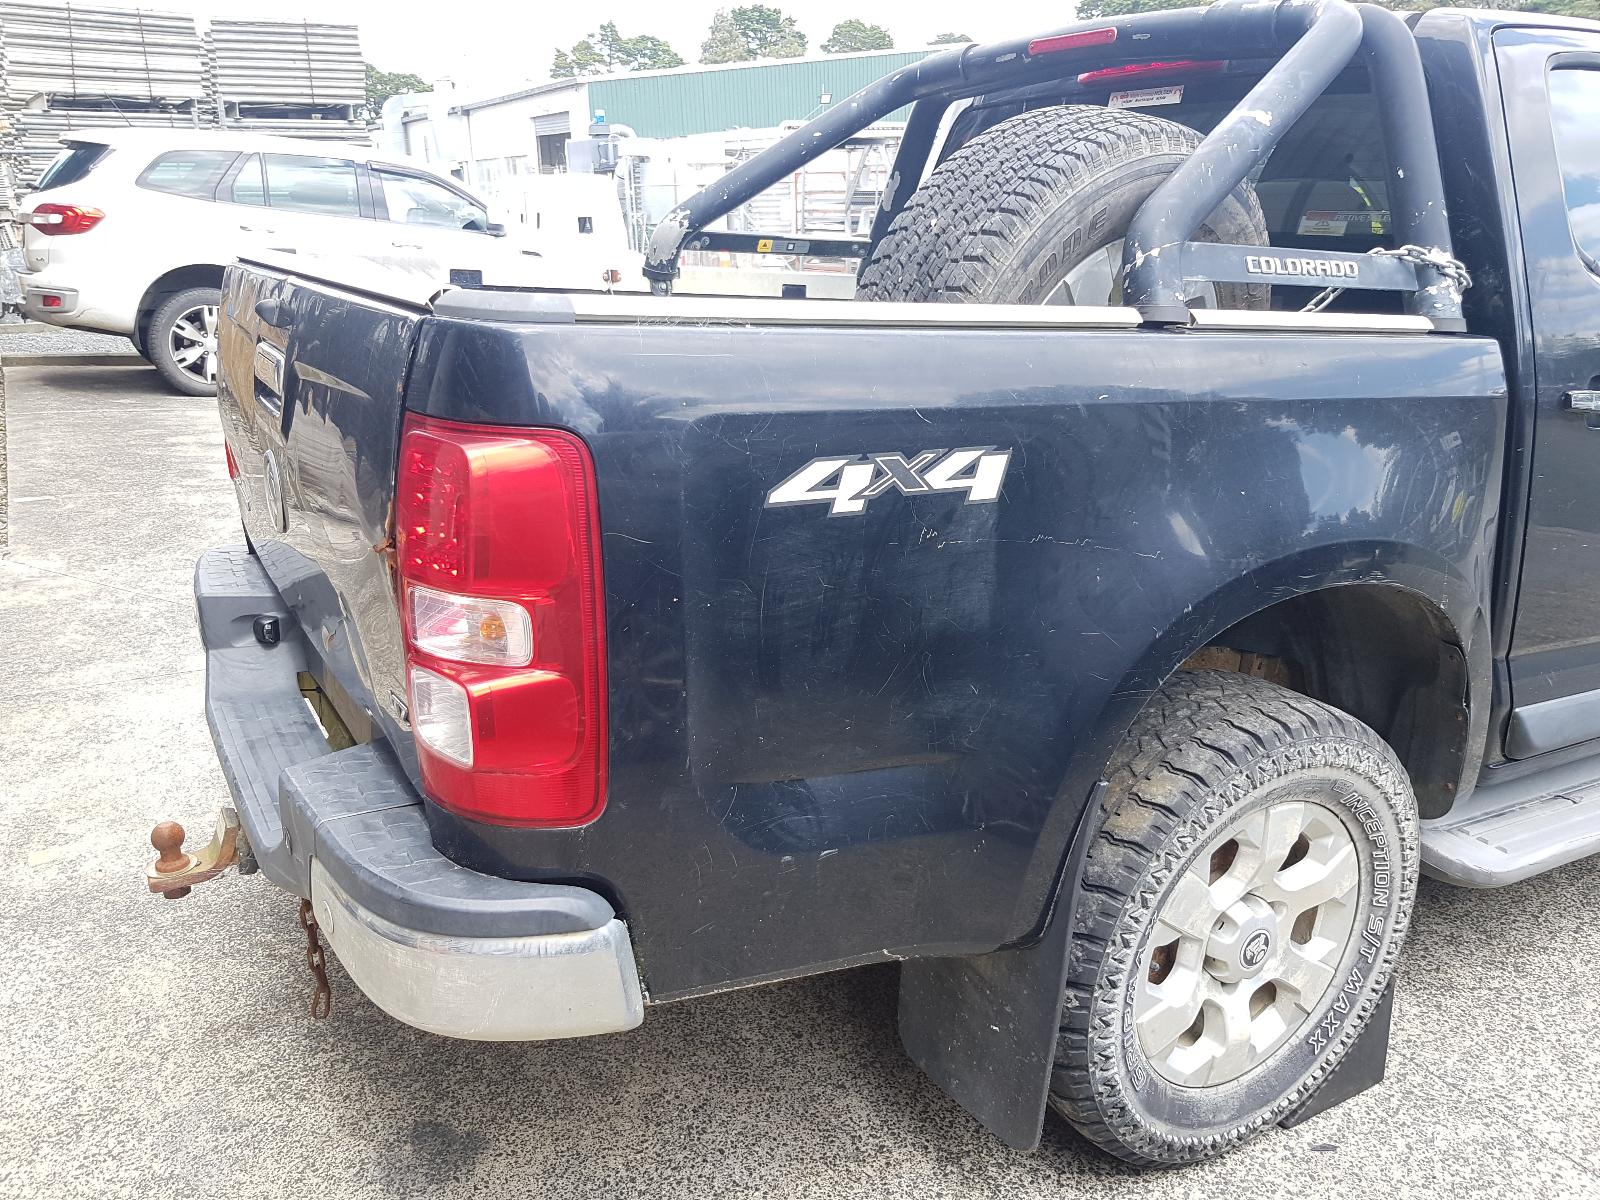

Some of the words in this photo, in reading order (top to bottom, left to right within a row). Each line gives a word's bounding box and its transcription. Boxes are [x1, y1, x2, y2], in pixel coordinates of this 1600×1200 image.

[1244, 255, 1360, 278] COLORADO
[1340, 791, 1391, 908] INCEPTION
[1360, 914, 1384, 964] S/T
[1308, 966, 1364, 1056] MAXX
